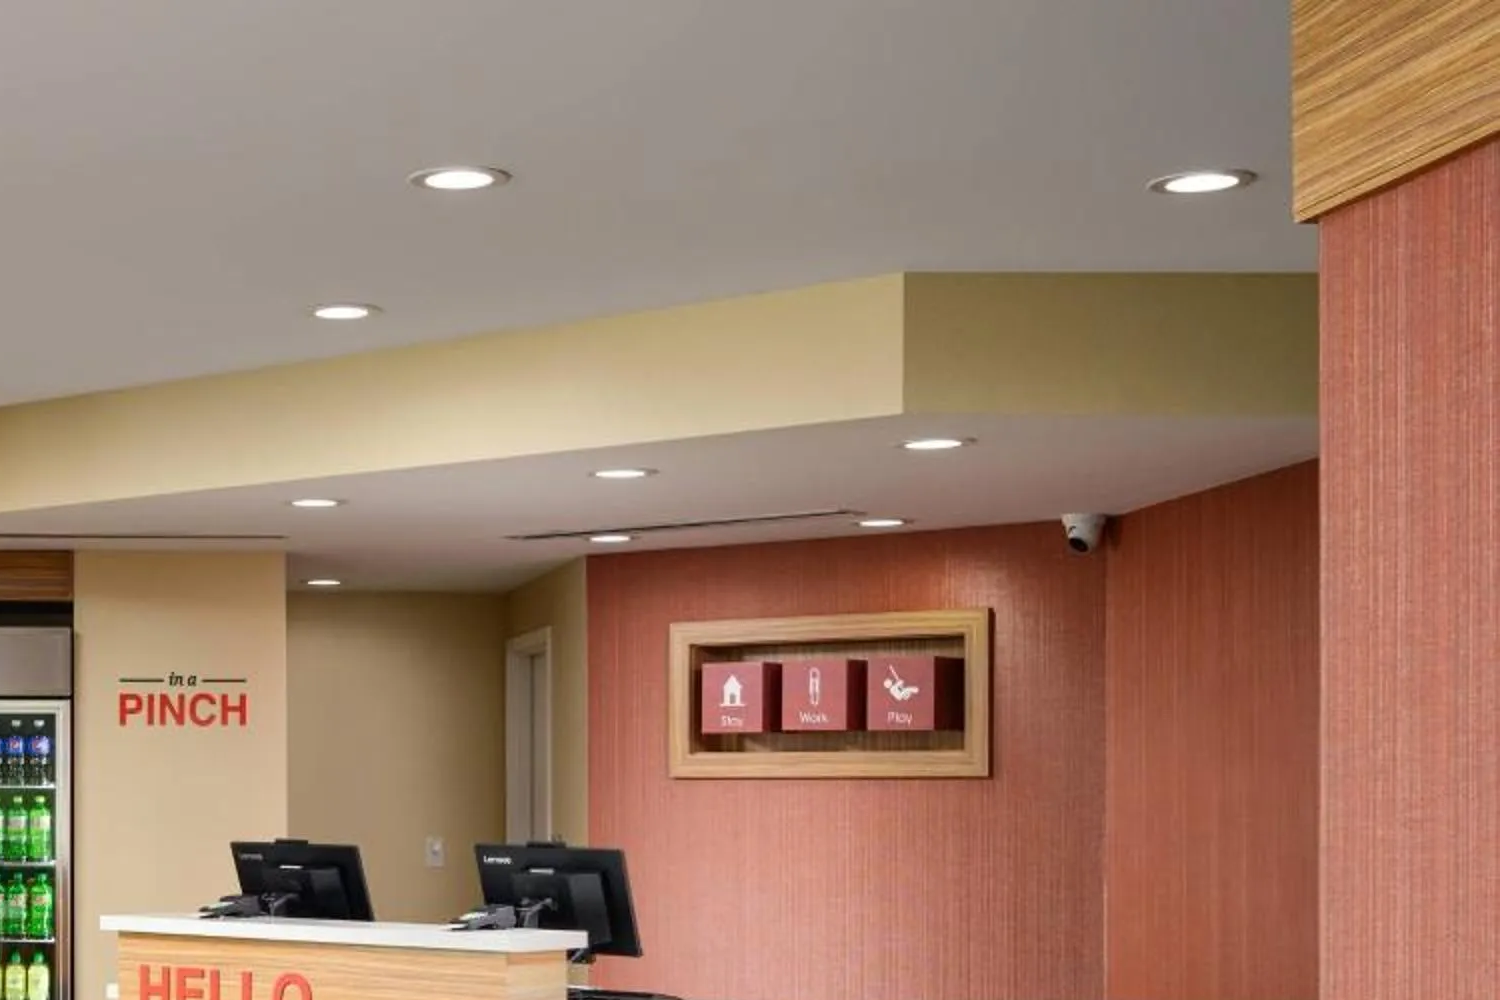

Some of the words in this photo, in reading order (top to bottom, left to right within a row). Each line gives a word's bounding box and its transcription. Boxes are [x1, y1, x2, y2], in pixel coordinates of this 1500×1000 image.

[168, 671, 184, 686] in
[187, 674, 197, 687] a
[119, 692, 247, 727] PINCH
[799, 711, 829, 724] Work
[887, 711, 913, 726] Play
